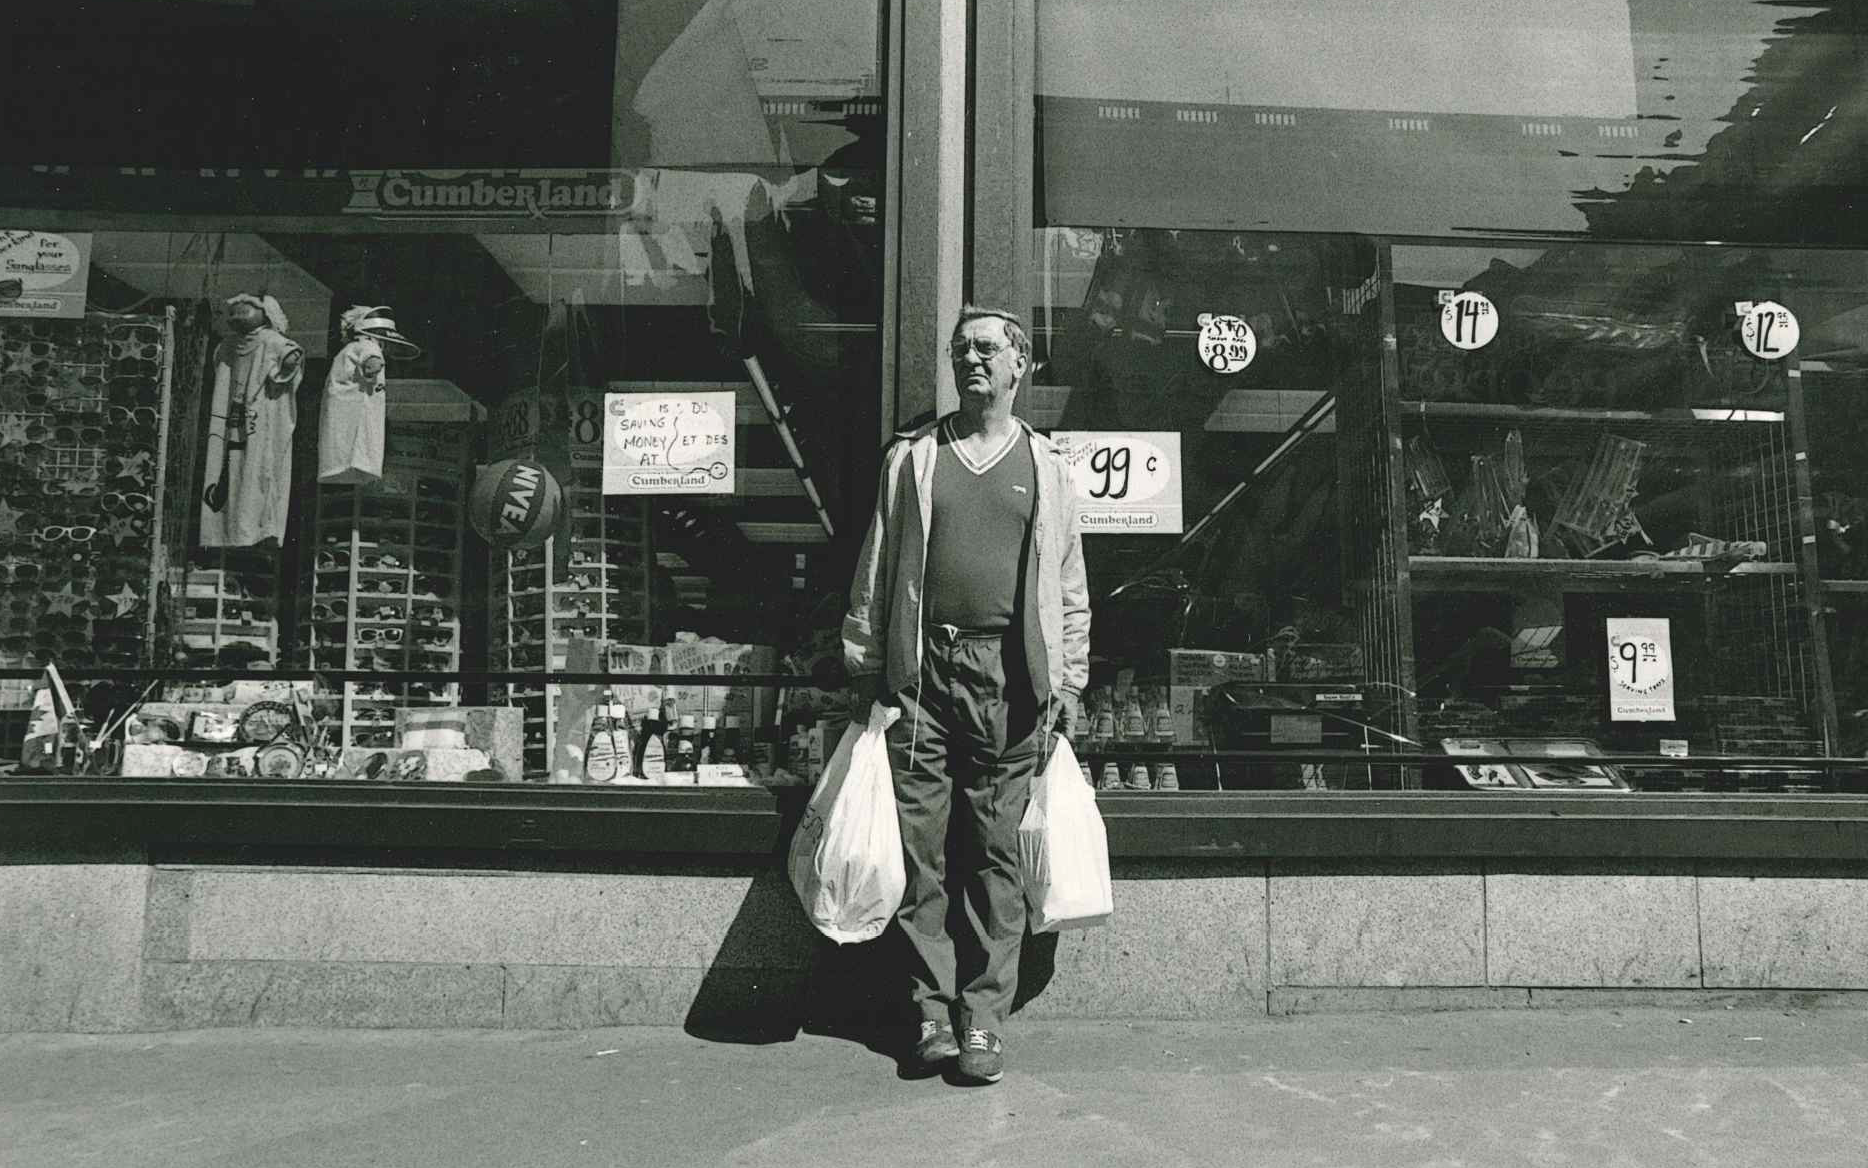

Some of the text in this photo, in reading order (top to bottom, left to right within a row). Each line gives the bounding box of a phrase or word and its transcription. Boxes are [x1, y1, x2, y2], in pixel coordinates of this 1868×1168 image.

[382, 177, 621, 218] Cumberland
[620, 417, 666, 431] SAVING
[624, 436, 666, 450] MONEY
[706, 435, 728, 445] DES
[640, 453, 660, 467] AT
[1089, 447, 1131, 500] 99
[631, 476, 706, 489] Cumberland
[496, 464, 541, 534] NIVEA
[1080, 514, 1153, 528] Cumberland
